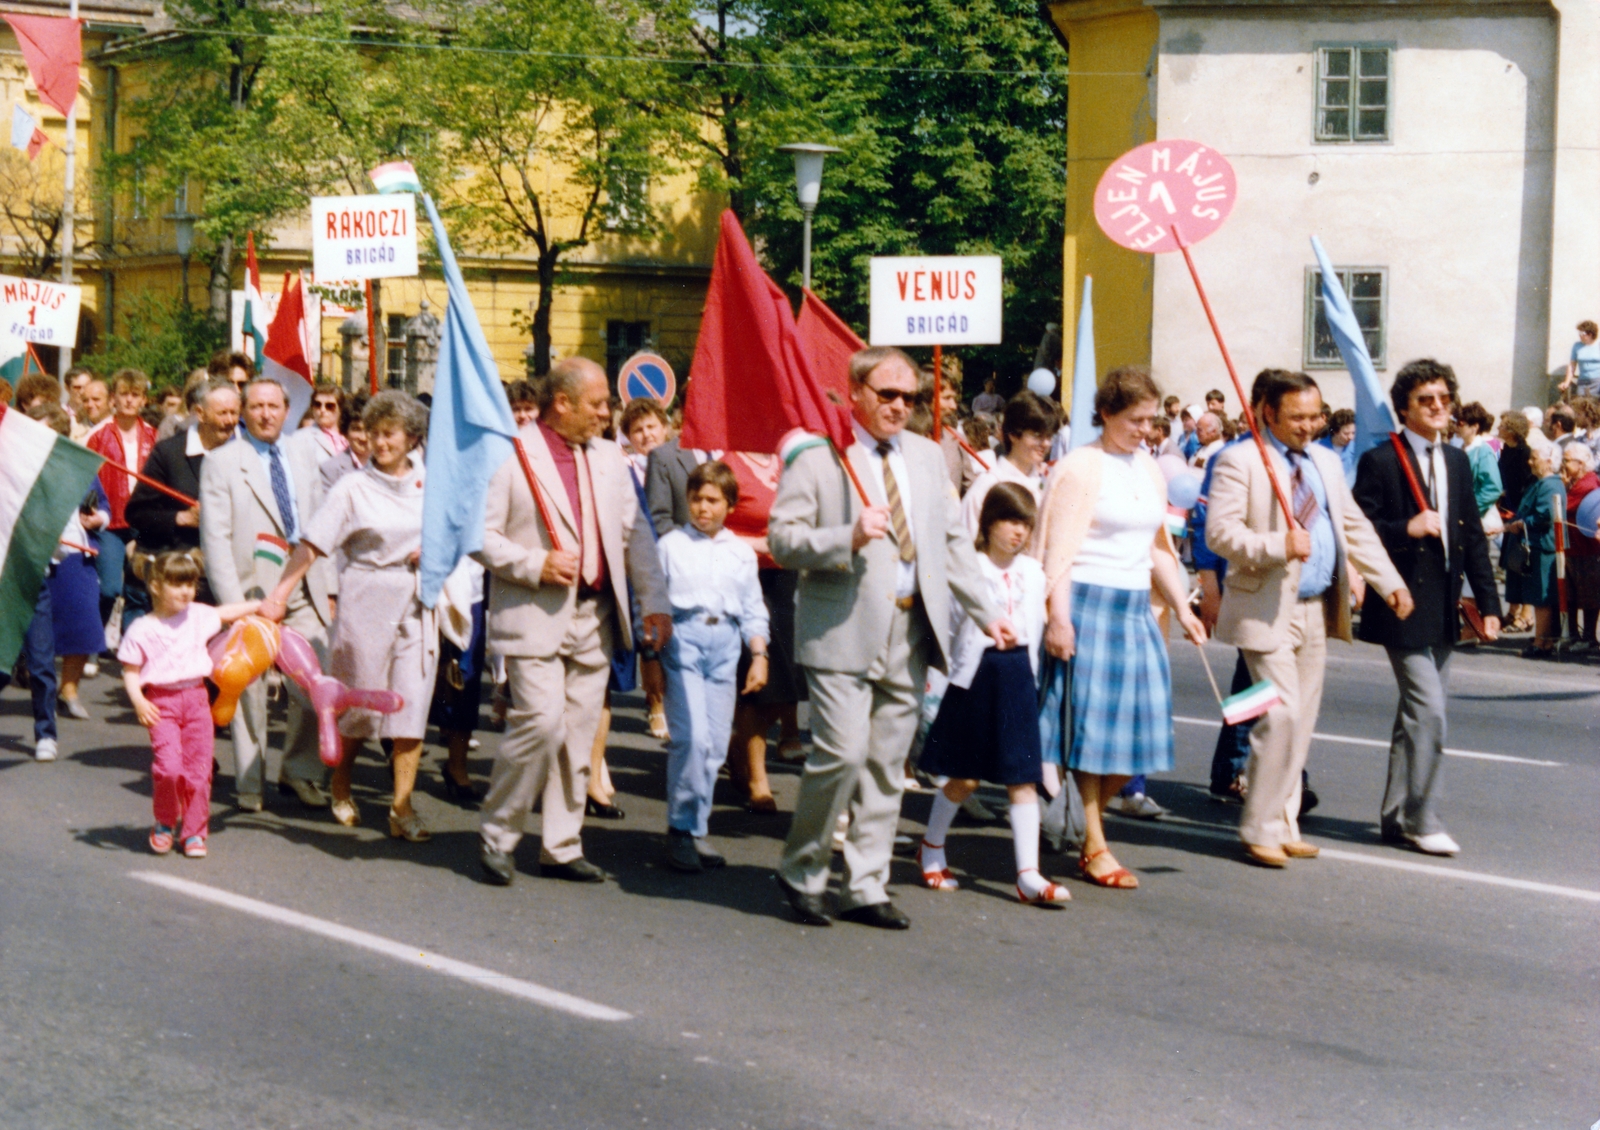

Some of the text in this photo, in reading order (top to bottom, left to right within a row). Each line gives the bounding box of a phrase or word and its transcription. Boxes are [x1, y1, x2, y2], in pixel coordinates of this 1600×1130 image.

[1107, 147, 1227, 249] ÉLJEN MÁJUS
[1148, 180, 1177, 215] 1
[346, 242, 395, 265] BRIGÁD
[897, 265, 976, 301] VÉNUS
[28, 305, 36, 326] 1
